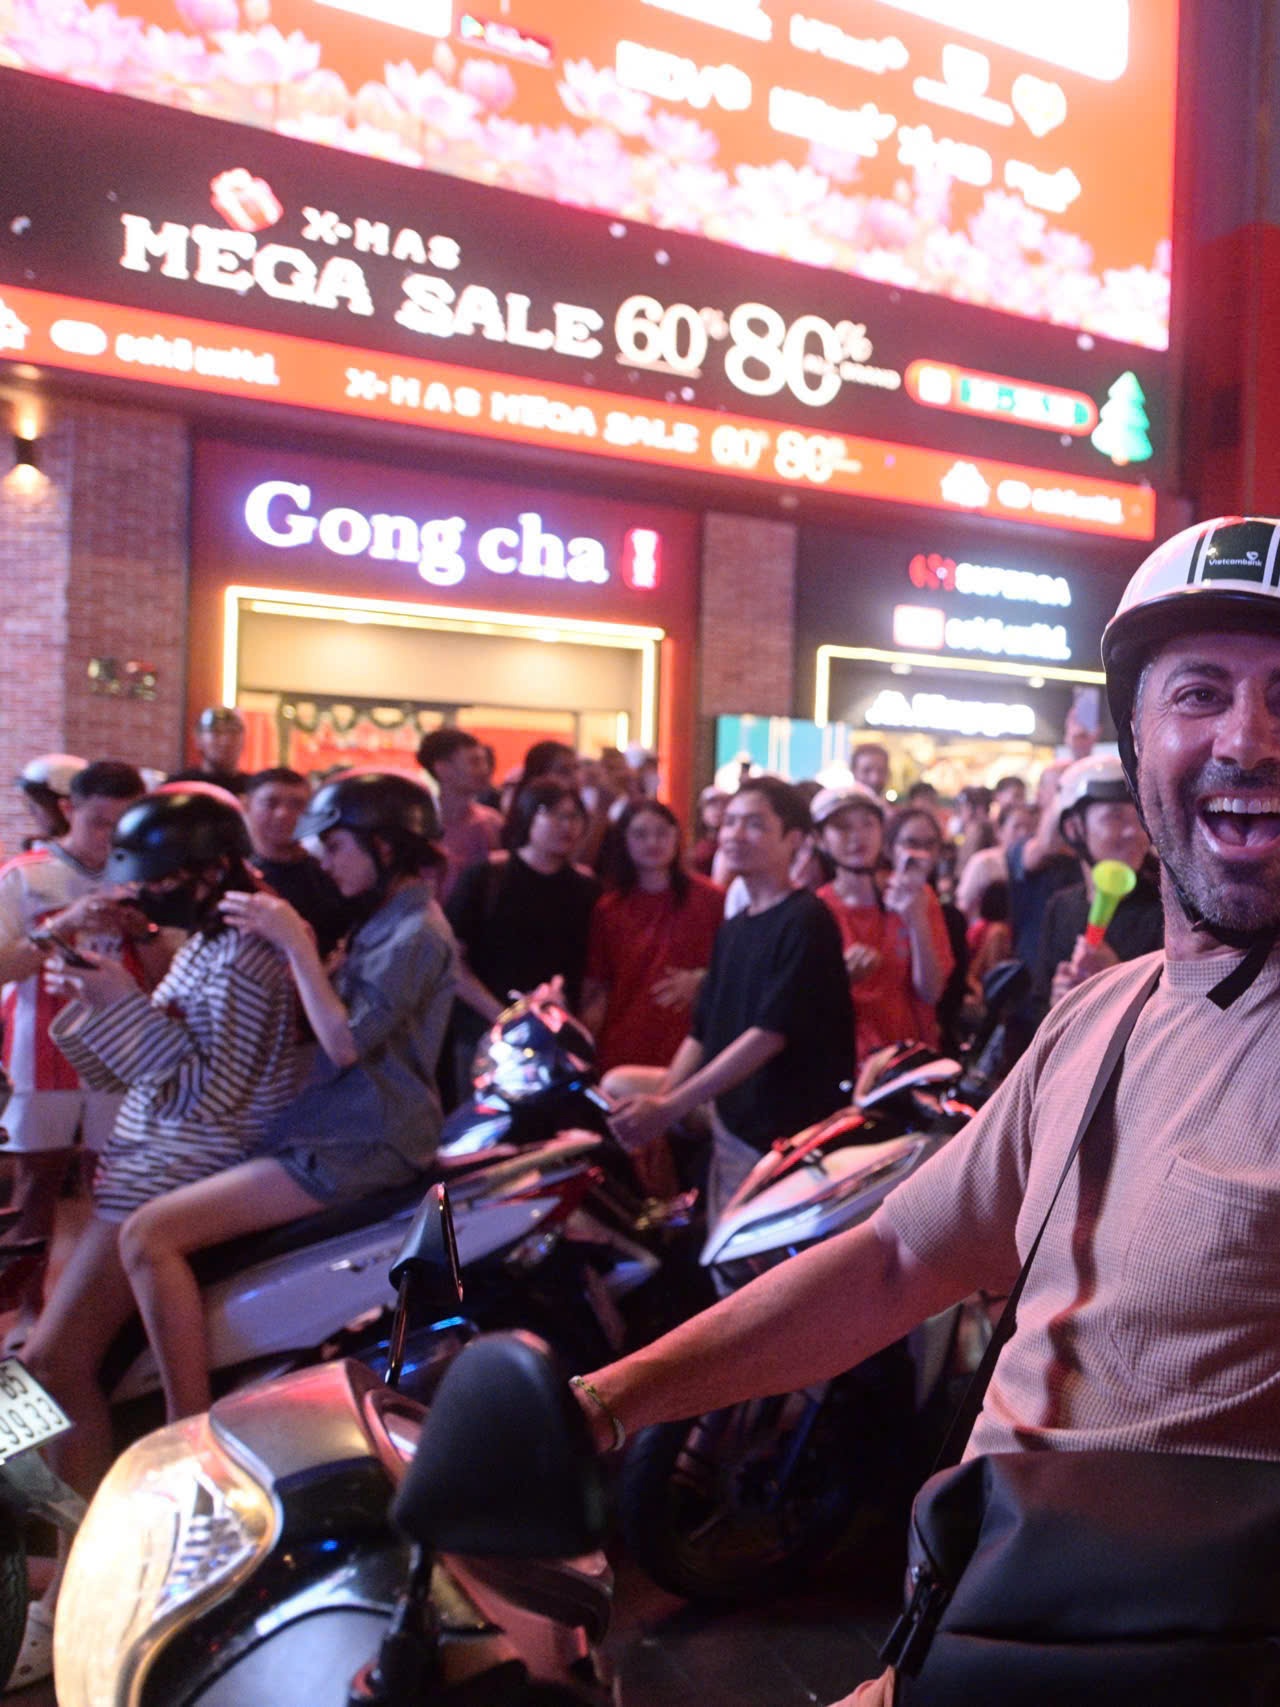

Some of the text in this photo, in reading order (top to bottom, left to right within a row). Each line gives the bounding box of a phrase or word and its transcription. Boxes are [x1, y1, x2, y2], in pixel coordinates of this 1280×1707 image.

[302, 206, 460, 270] X-MAS
[119, 213, 374, 318] MEGA
[395, 273, 603, 360] SALE
[345, 367, 481, 418] X-MAS
[490, 391, 597, 437] MEGA
[244, 480, 610, 586] Gong cha
[1208, 558, 1262, 568] Vietcombank
